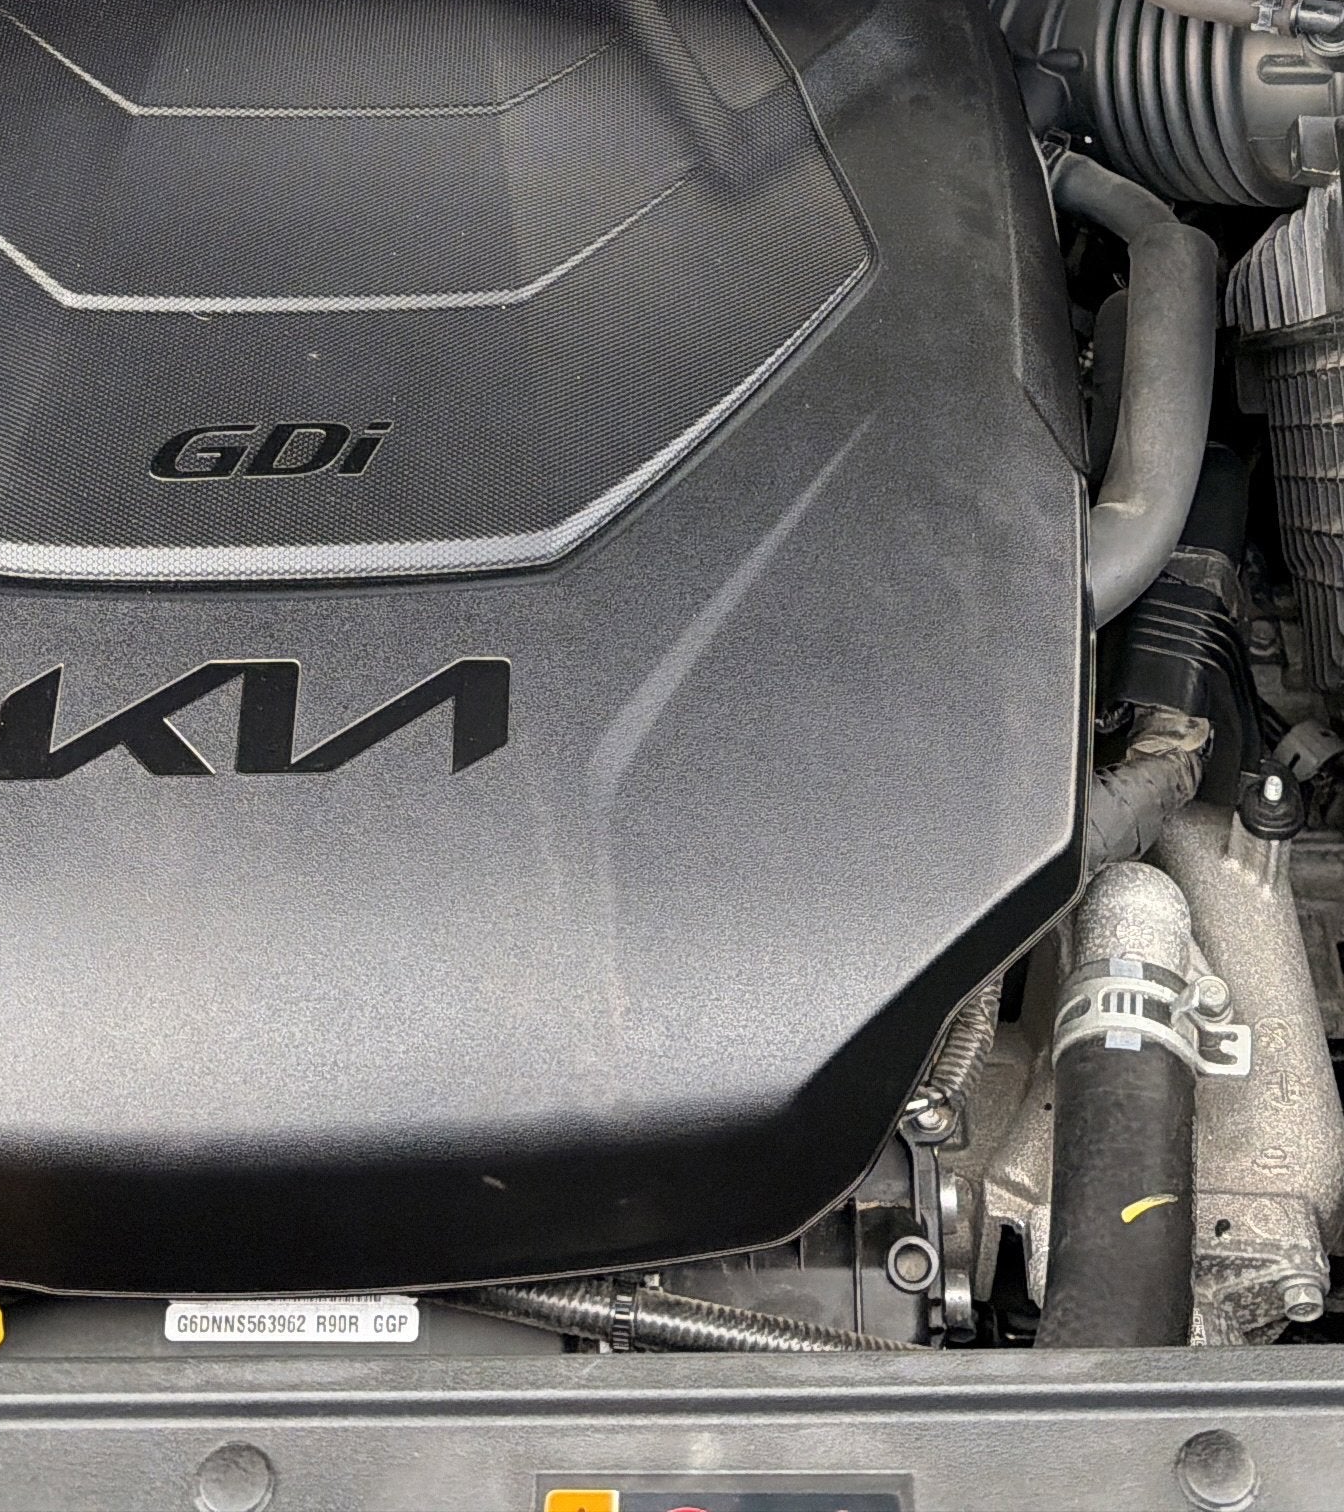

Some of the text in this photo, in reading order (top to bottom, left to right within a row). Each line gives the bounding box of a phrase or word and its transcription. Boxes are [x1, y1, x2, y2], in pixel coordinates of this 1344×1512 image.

[149, 420, 396, 482] GDi
[176, 1314, 307, 1334] G6DNNS563962
[373, 1314, 409, 1334] GGP
